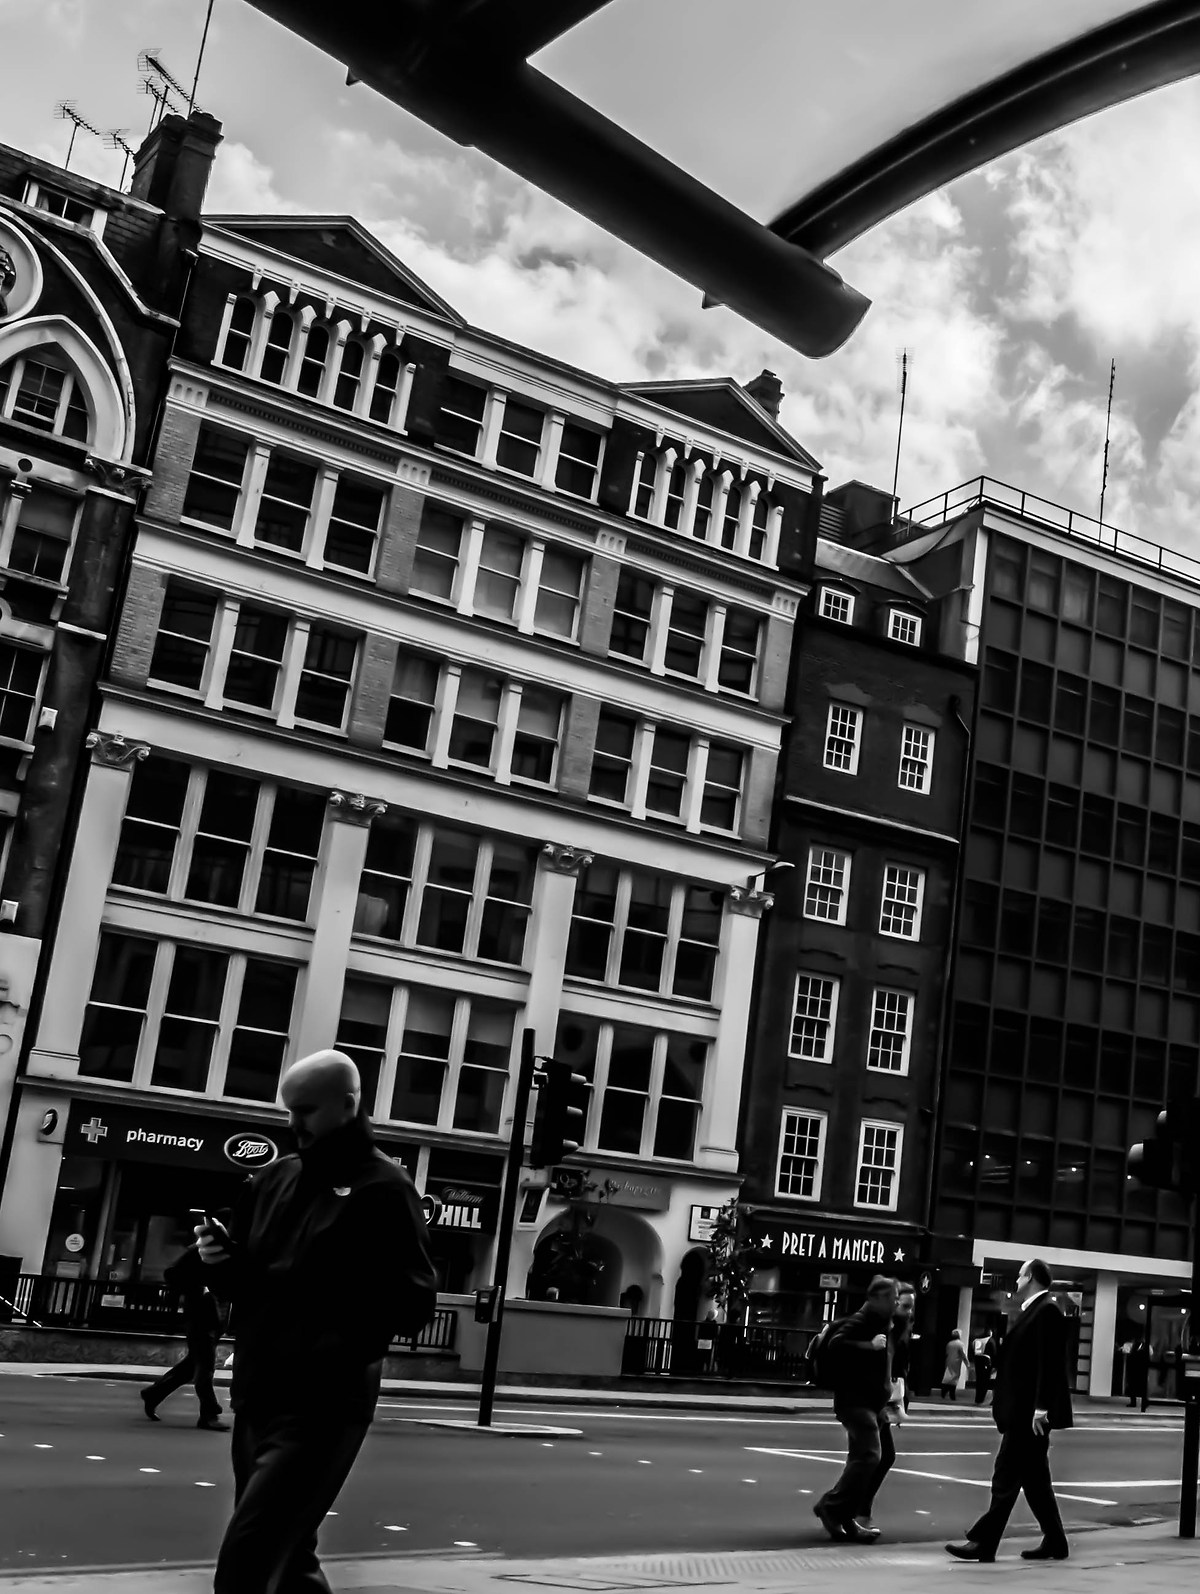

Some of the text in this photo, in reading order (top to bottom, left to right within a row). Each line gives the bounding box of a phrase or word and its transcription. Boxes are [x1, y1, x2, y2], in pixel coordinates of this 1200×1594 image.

[126, 1128, 204, 1151] pharmacy
[232, 1140, 269, 1158] Boots
[437, 1204, 481, 1229] HILL
[781, 1231, 885, 1264] PRET A MANGER
